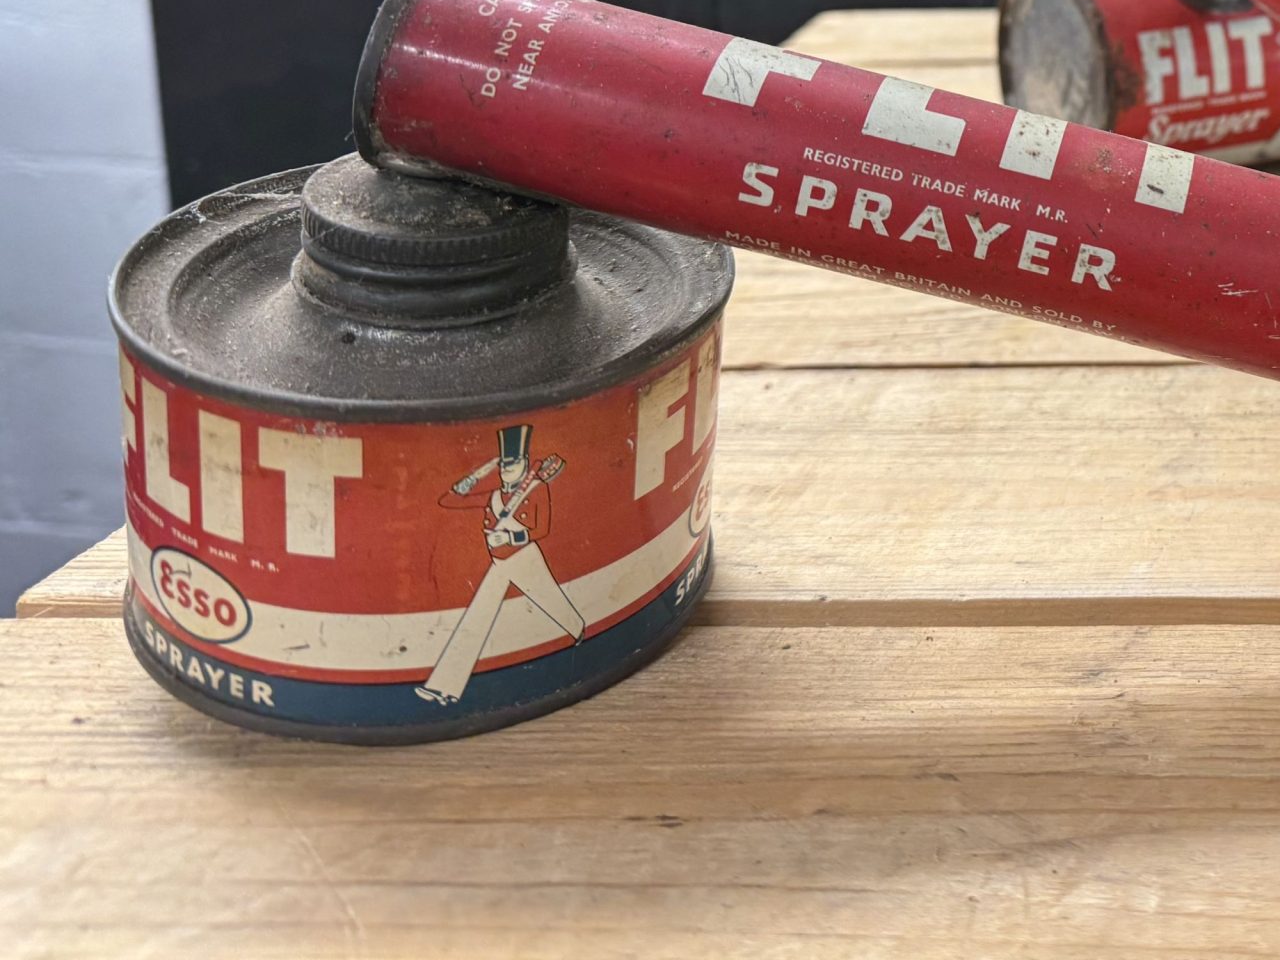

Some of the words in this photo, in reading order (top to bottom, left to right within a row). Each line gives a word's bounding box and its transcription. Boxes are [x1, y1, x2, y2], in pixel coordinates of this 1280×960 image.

[480, 67, 501, 98] DO
[494, 17, 523, 57] NOT
[512, 39, 545, 91] NEAR
[1137, 16, 1272, 106] FLIT
[803, 147, 904, 182] REGISTERED
[911, 172, 966, 198] TRADE
[974, 187, 1022, 211] MARK
[738, 162, 1116, 292] SPRAYER
[725, 230, 781, 250] MADE
[791, 246, 812, 258] IN
[821, 253, 885, 275] GREAT
[895, 271, 971, 296] BRITAIN
[981, 293, 1023, 308] AND
[1032, 305, 1083, 324] SOLD
[1092, 319, 1117, 332] BY
[171, 526, 199, 550] TRADE
[208, 545, 238, 563] MARK
[145, 620, 275, 707] SPRAYER
